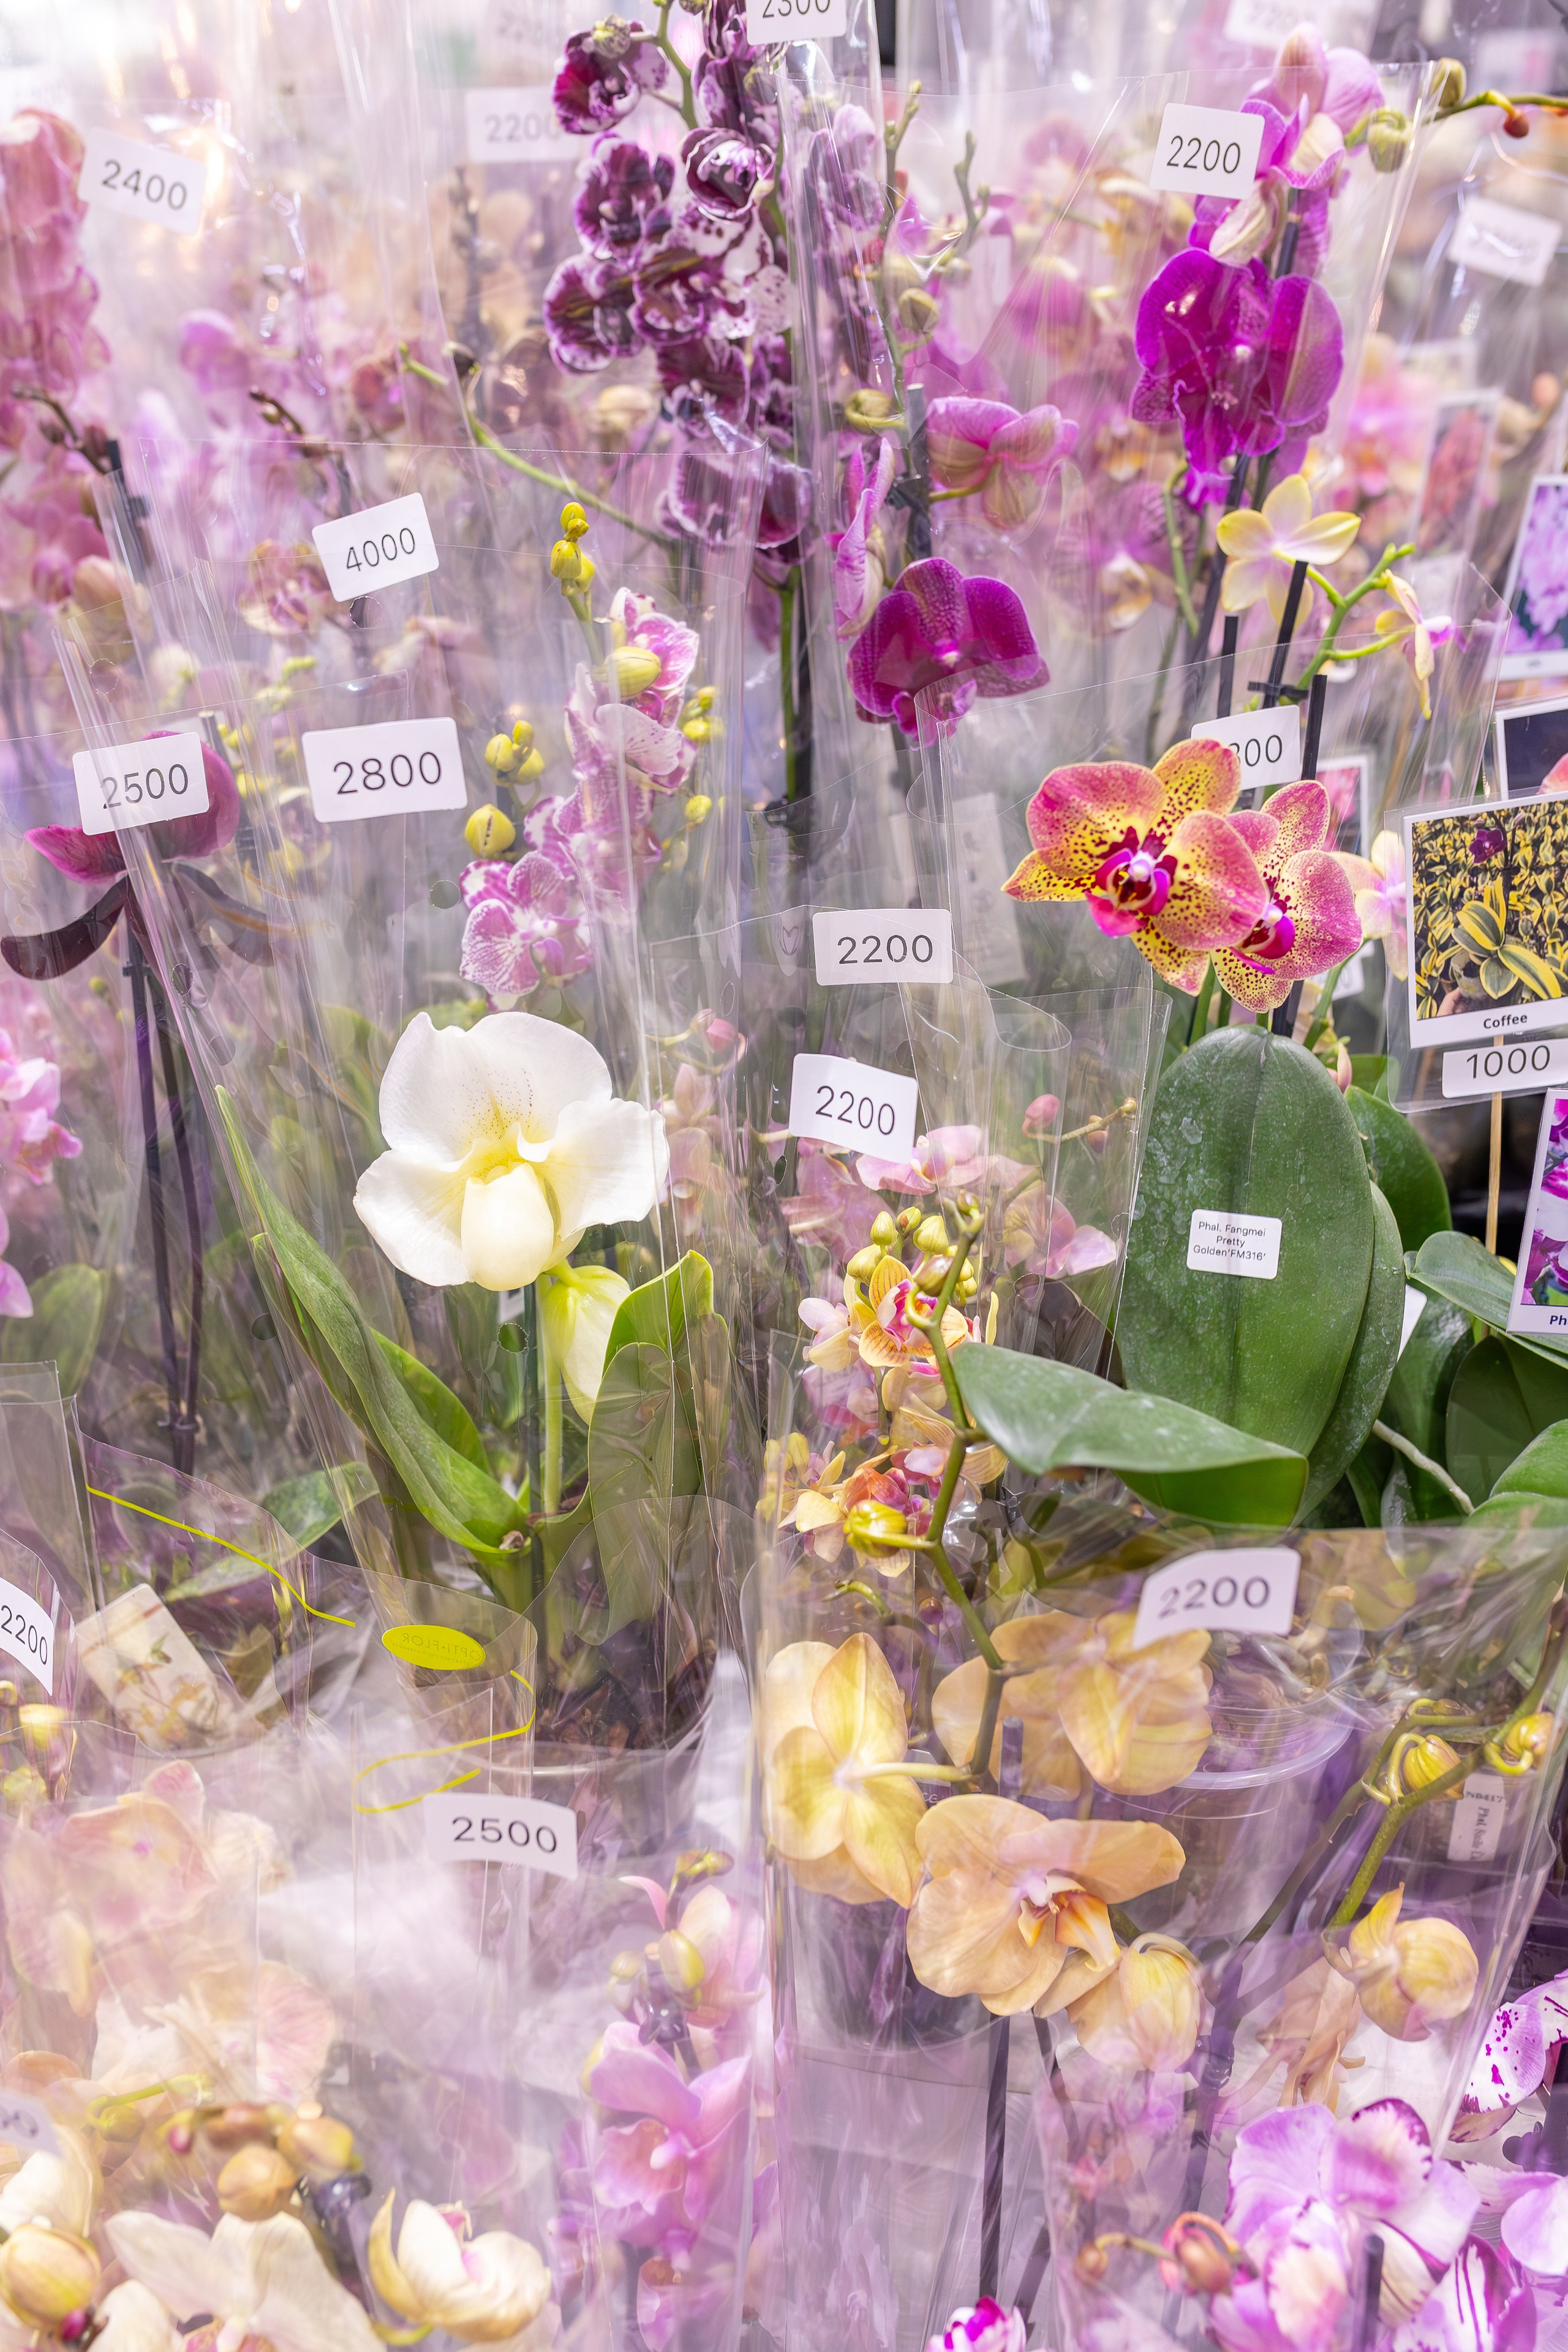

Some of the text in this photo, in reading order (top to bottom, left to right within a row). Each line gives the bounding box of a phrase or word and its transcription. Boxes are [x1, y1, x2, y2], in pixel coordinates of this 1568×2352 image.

[1167, 135, 1241, 175] 2200
[101, 159, 187, 211] 2400
[346, 527, 416, 572] 4000
[100, 763, 189, 809] 2500
[333, 751, 442, 795] 2800
[837, 934, 933, 965] 2200
[1483, 1014, 1528, 1029] Coffee
[1466, 1045, 1550, 1079] 1000
[815, 1085, 895, 1136] 2200
[1198, 1221, 1266, 1237] Phal. Fangmei
[1216, 1235, 1245, 1248] Pretty
[1550, 1315, 1568, 1325] Ph
[1158, 1576, 1270, 1619] 2200
[1, 1605, 48, 1665] 2200
[452, 1817, 557, 1853] 2500
